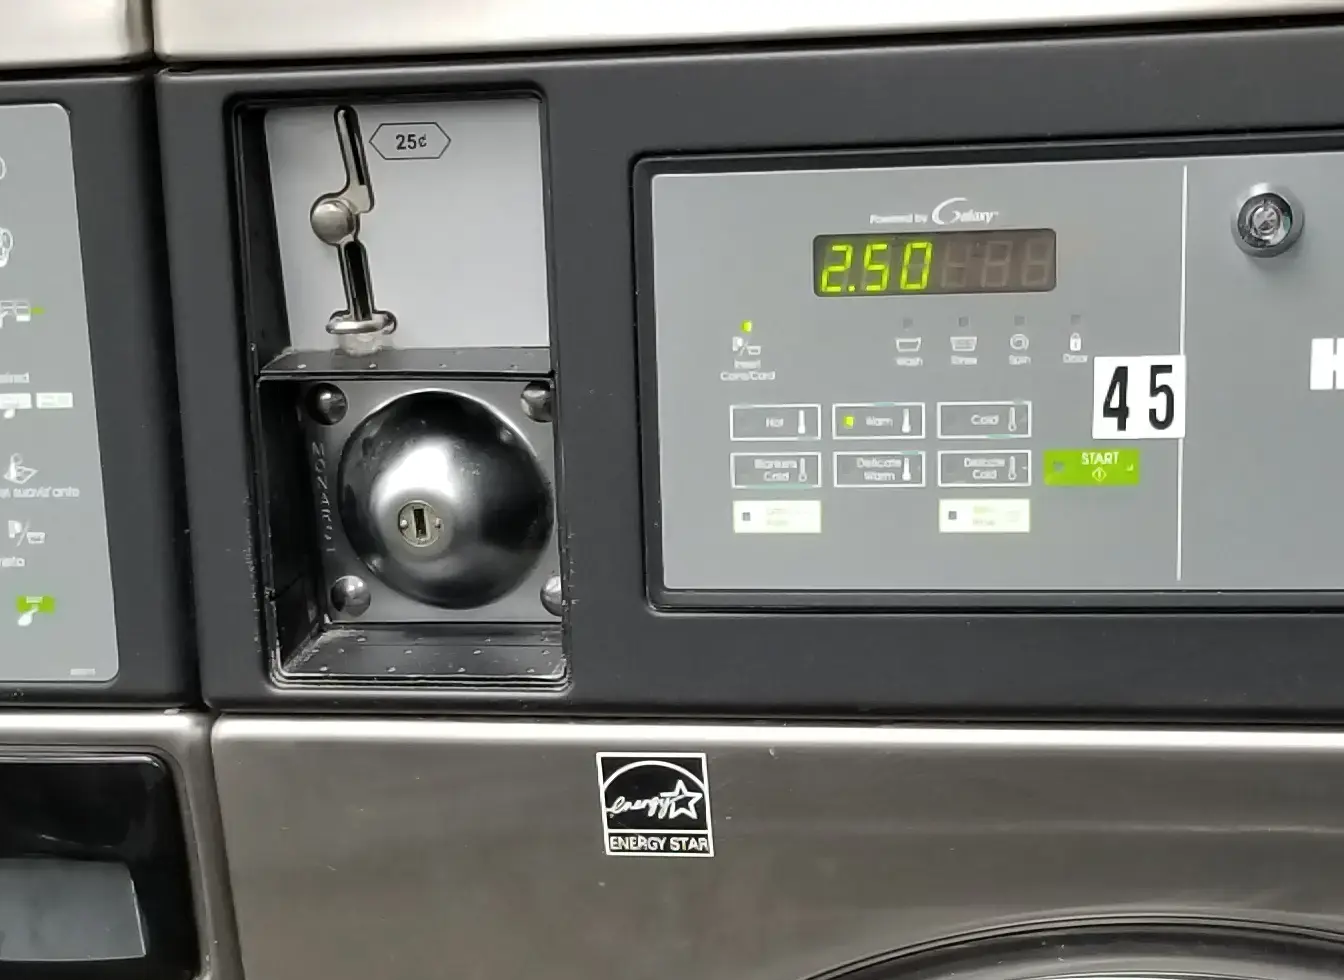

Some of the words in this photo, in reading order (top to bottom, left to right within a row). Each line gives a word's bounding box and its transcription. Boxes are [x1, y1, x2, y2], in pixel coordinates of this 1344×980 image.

[395, 133, 427, 150] 25¢
[820, 241, 934, 293] 2.50
[1102, 363, 1175, 432] 45
[1080, 451, 1120, 465] START
[609, 836, 667, 851] ENERGY
[669, 836, 709, 851] STAR
